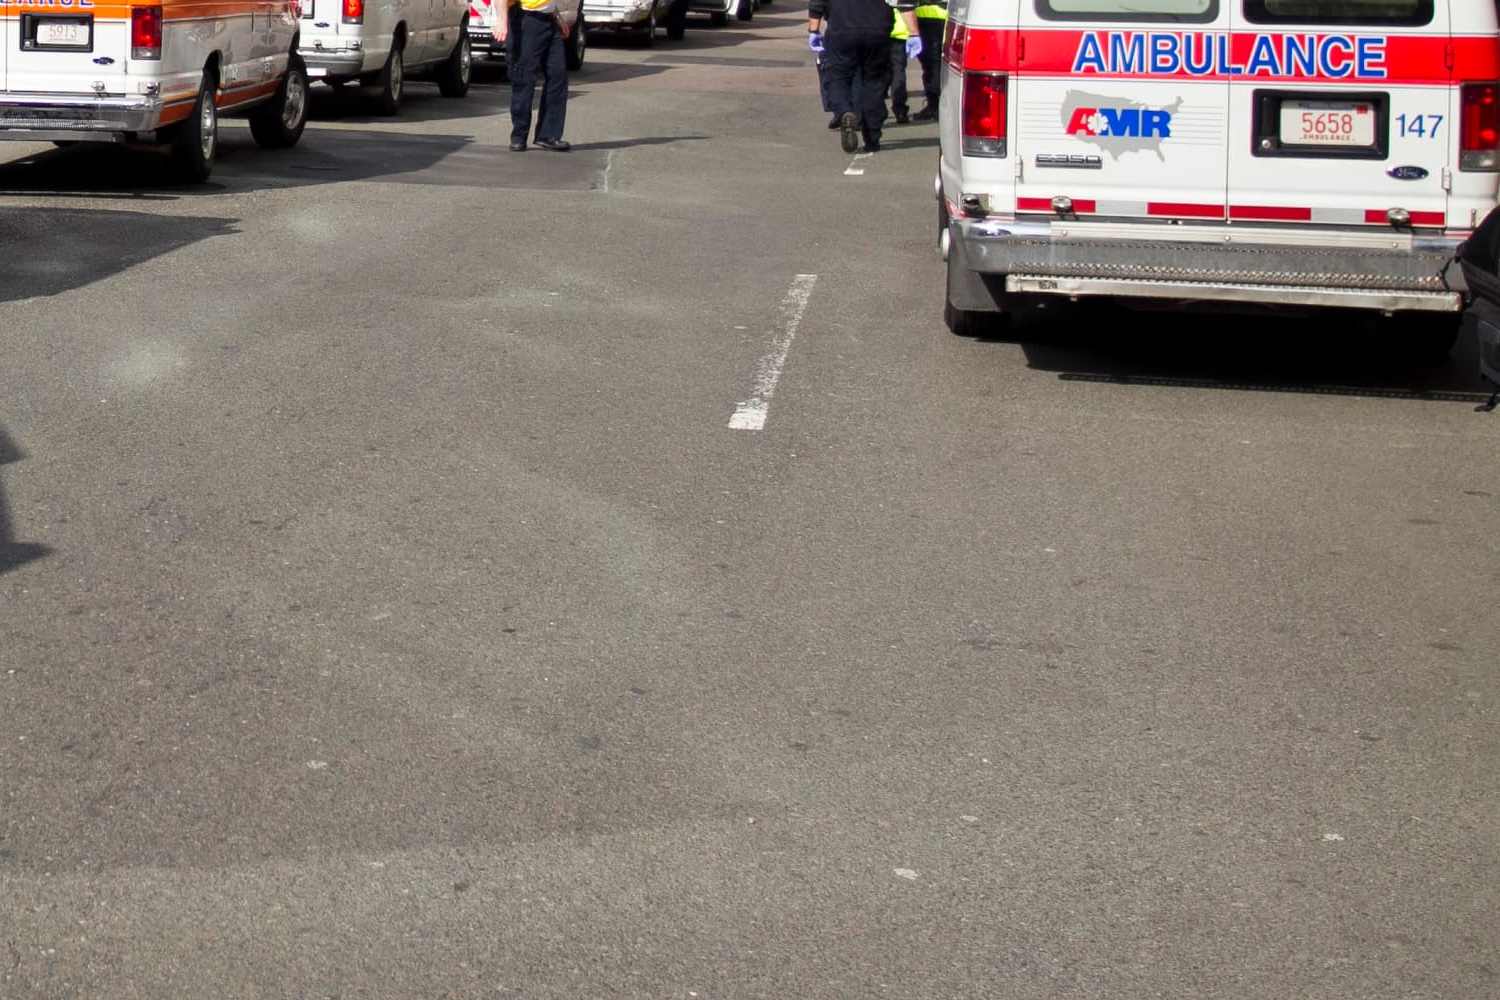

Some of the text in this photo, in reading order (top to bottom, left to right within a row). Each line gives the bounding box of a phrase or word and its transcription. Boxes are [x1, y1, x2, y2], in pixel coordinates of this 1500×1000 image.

[1071, 31, 1387, 79] AMBULANCE
[1065, 107, 1172, 138] AMR
[1301, 112, 1353, 134] 5658
[1395, 113, 1444, 139] 147
[1303, 134, 1351, 142] AMBULANCE
